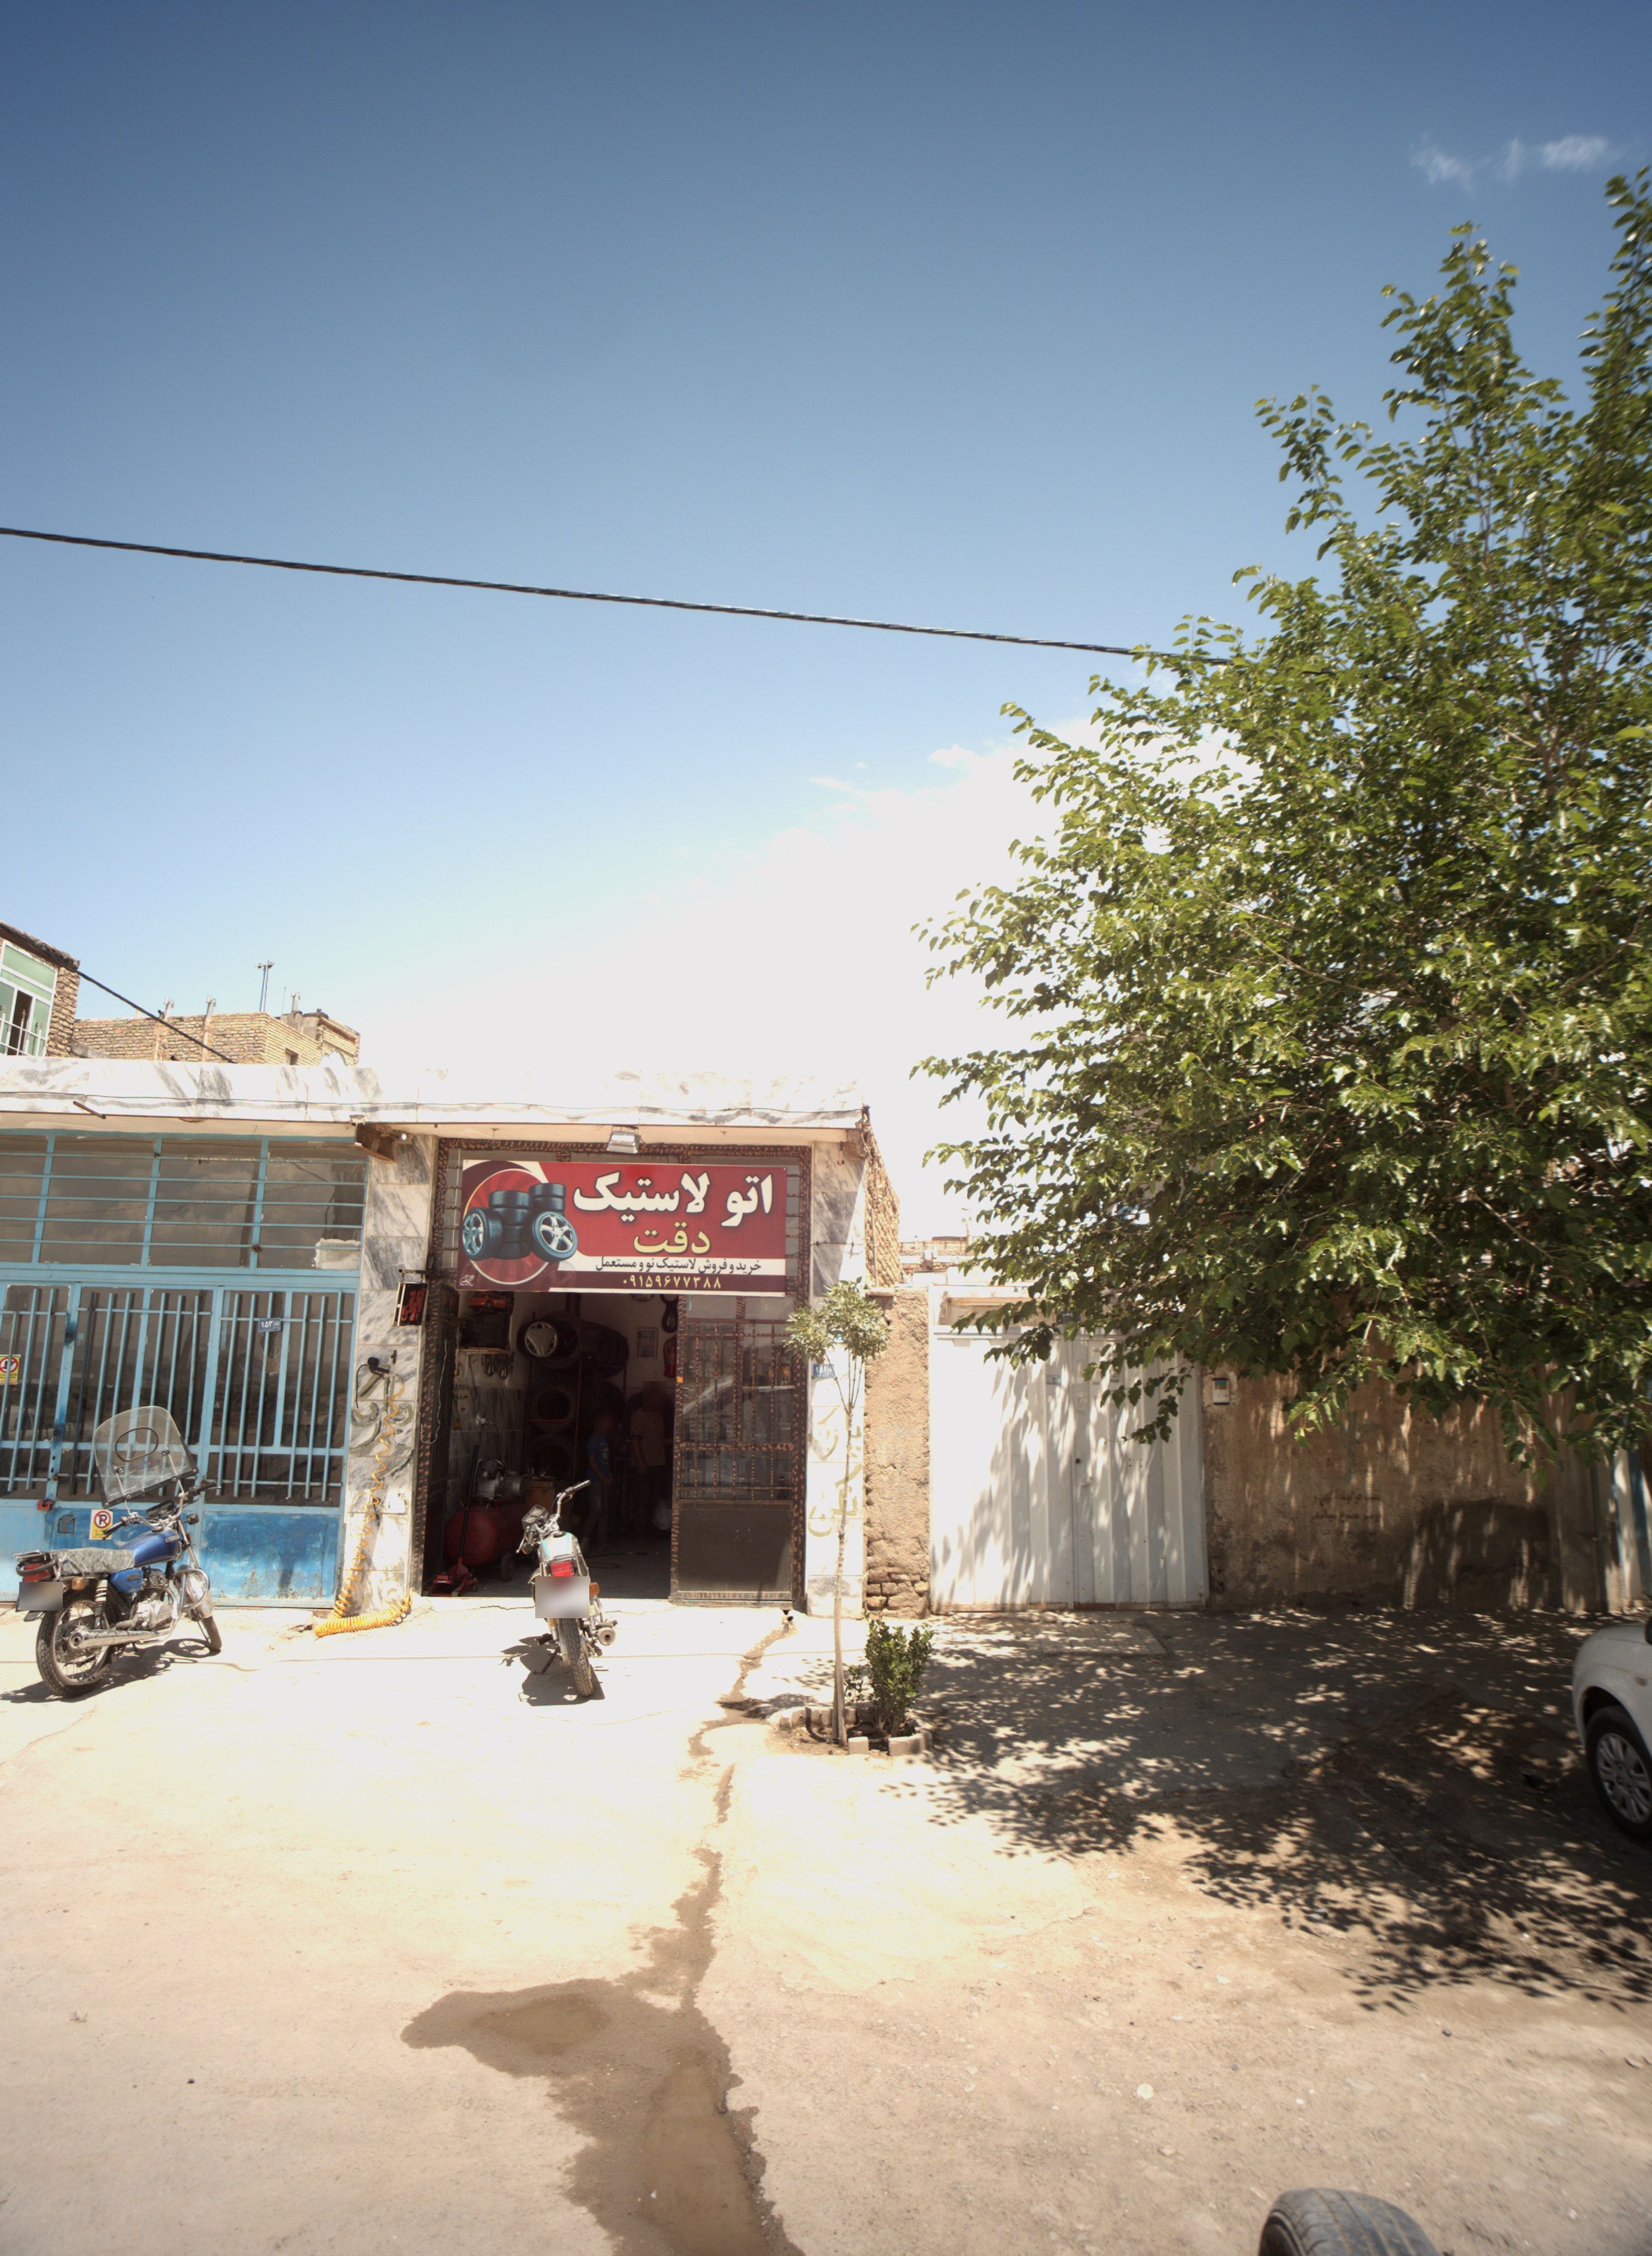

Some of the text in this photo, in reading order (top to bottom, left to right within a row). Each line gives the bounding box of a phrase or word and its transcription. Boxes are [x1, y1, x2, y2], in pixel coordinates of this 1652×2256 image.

[573, 1171, 773, 1227] اتو لاستیک
[634, 1221, 711, 1254] دقت
[596, 1256, 637, 1271] مستعمل
[646, 1257, 654, 1272] نو
[656, 1257, 696, 1272] لاستیک
[698, 1259, 727, 1275] فروش
[736, 1260, 762, 1275] خرید
[623, 1275, 721, 1289] ۰۹۱۵۹۶۷۷۳۸۸
